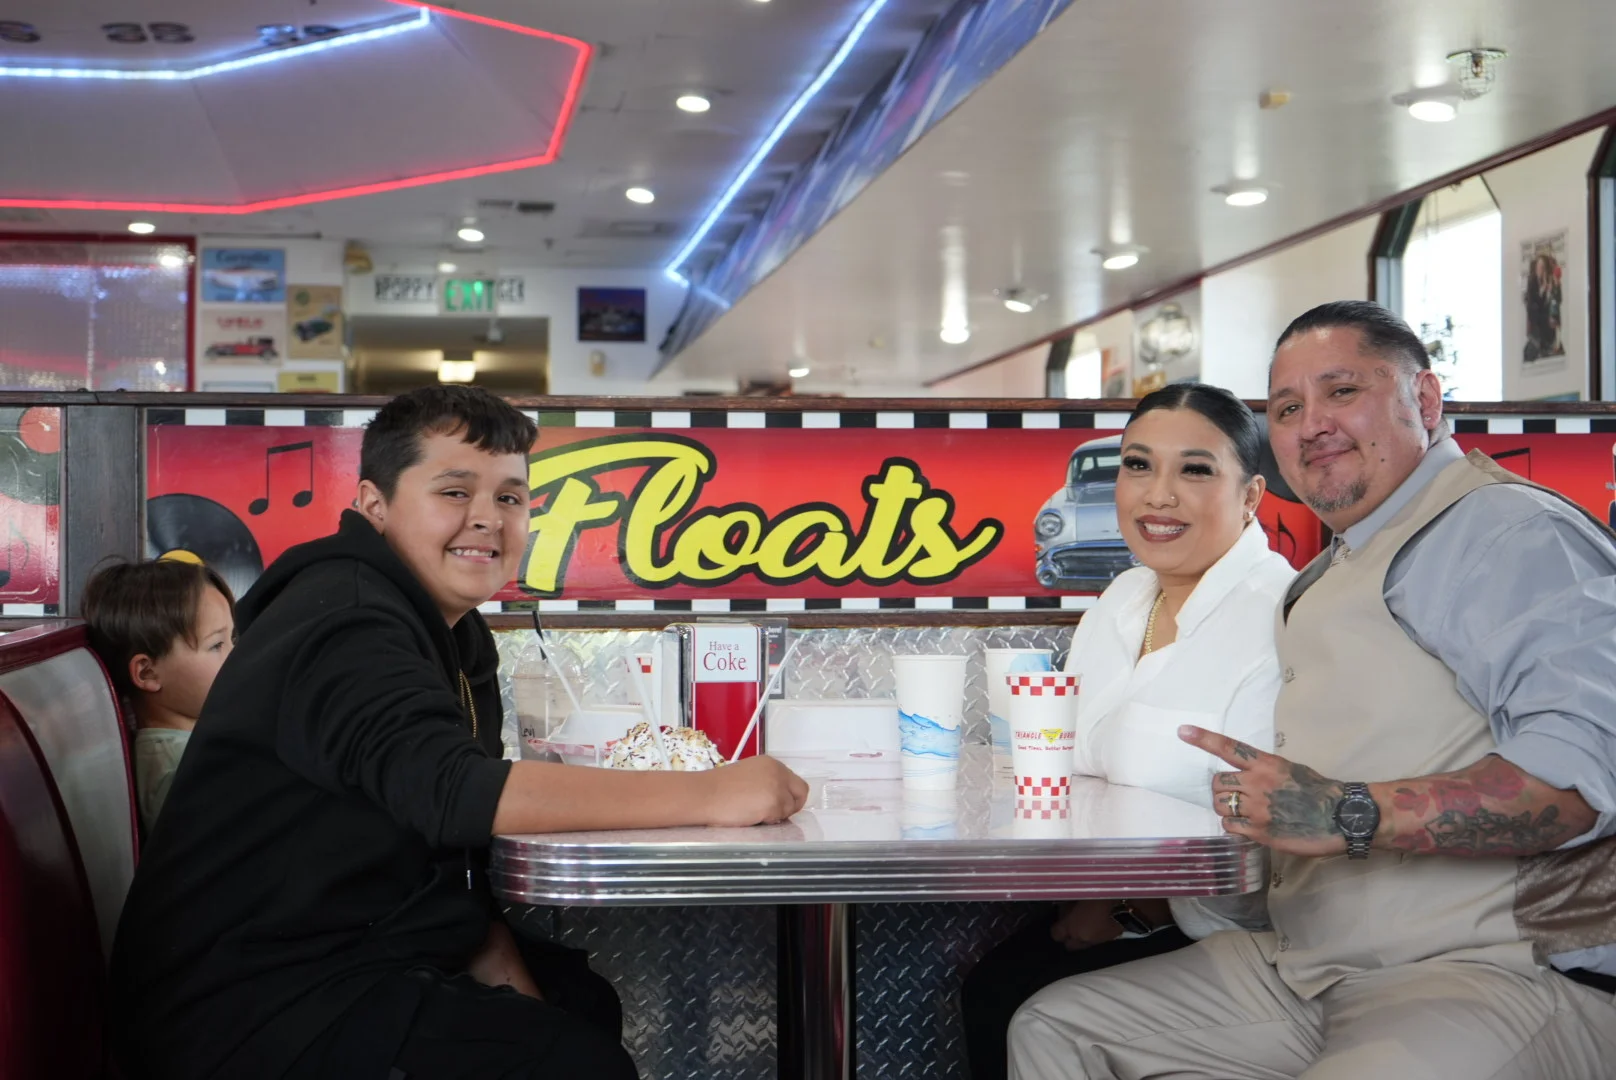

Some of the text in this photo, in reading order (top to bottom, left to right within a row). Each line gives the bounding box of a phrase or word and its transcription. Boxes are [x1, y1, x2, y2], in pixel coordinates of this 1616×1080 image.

[445, 280, 495, 311] EXIT
[518, 433, 1003, 597] Floats
[709, 641, 740, 651] Have a
[703, 652, 747, 671] Coke
[1015, 731, 1042, 740] TRIANGLE
